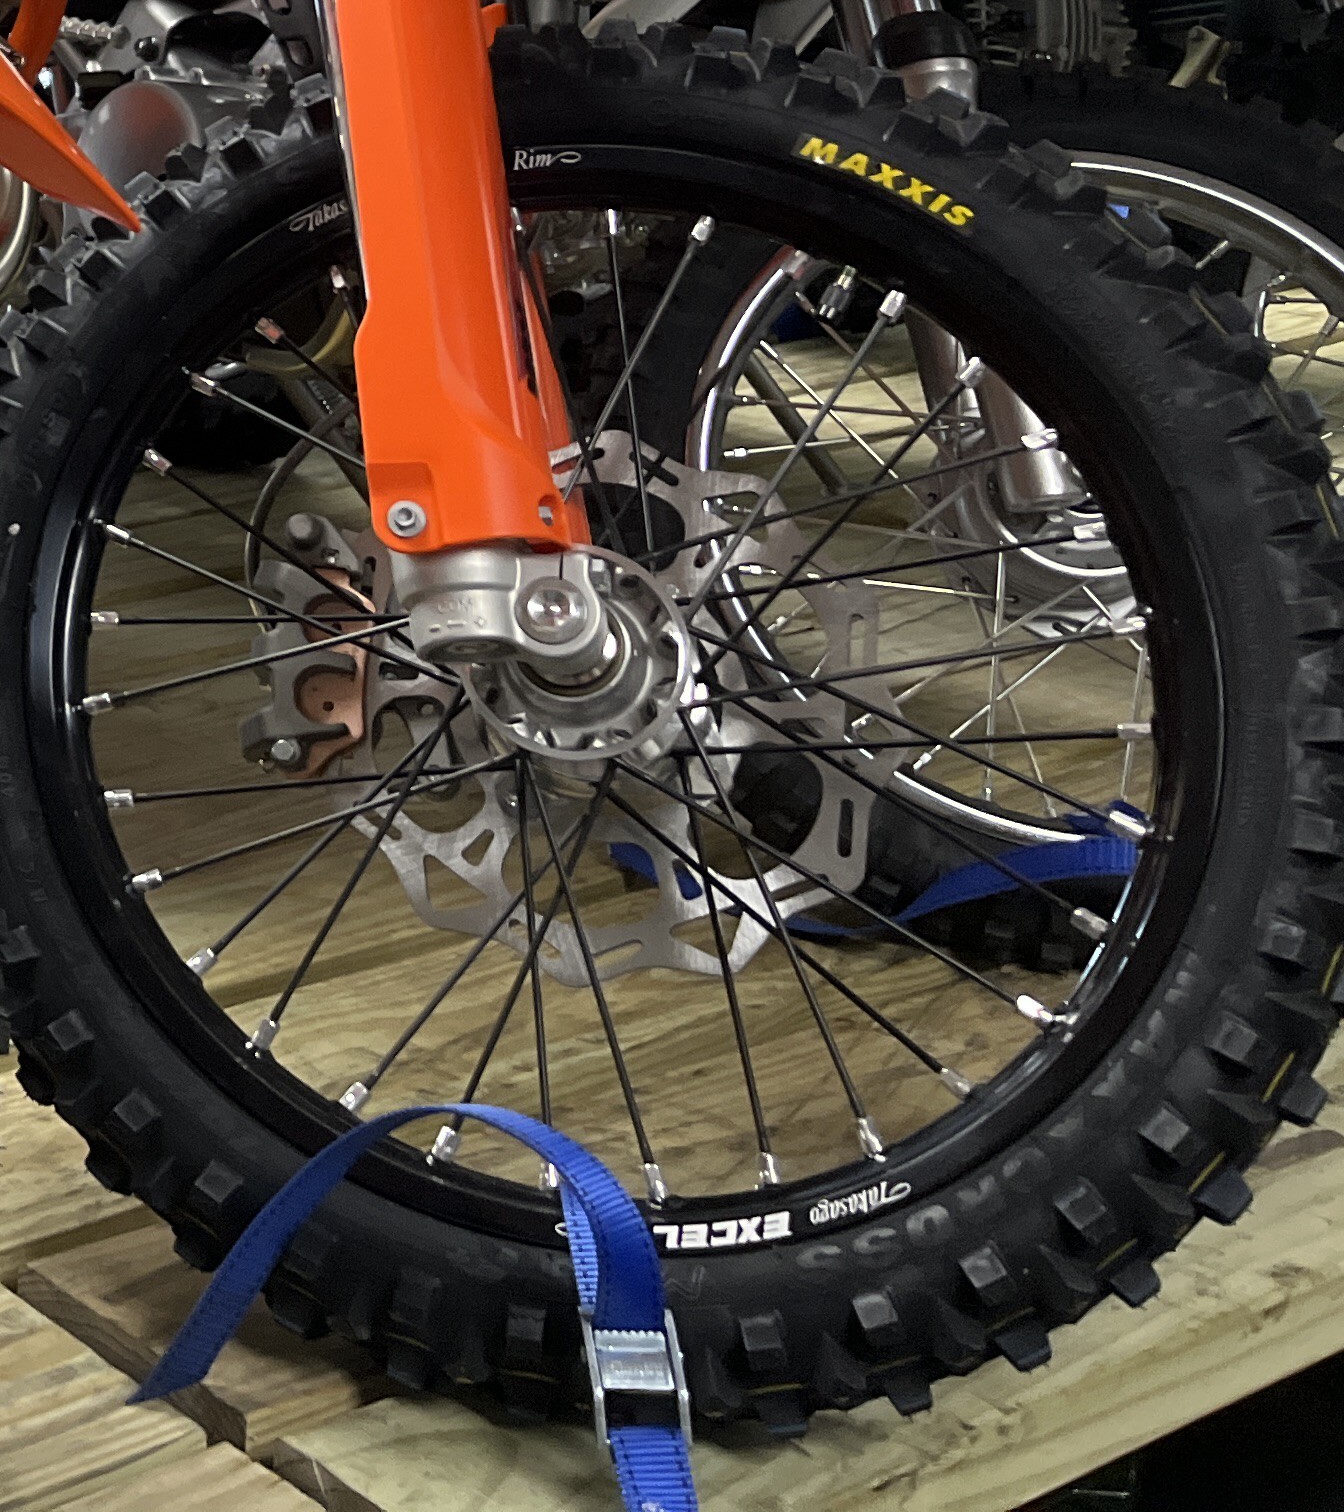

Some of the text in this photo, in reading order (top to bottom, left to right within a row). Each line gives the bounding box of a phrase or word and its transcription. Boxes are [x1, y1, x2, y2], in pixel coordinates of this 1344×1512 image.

[512, 147, 578, 172] Rim
[798, 135, 976, 227] MAXXIS
[652, 1180, 912, 1250] Takasago EXCEL
